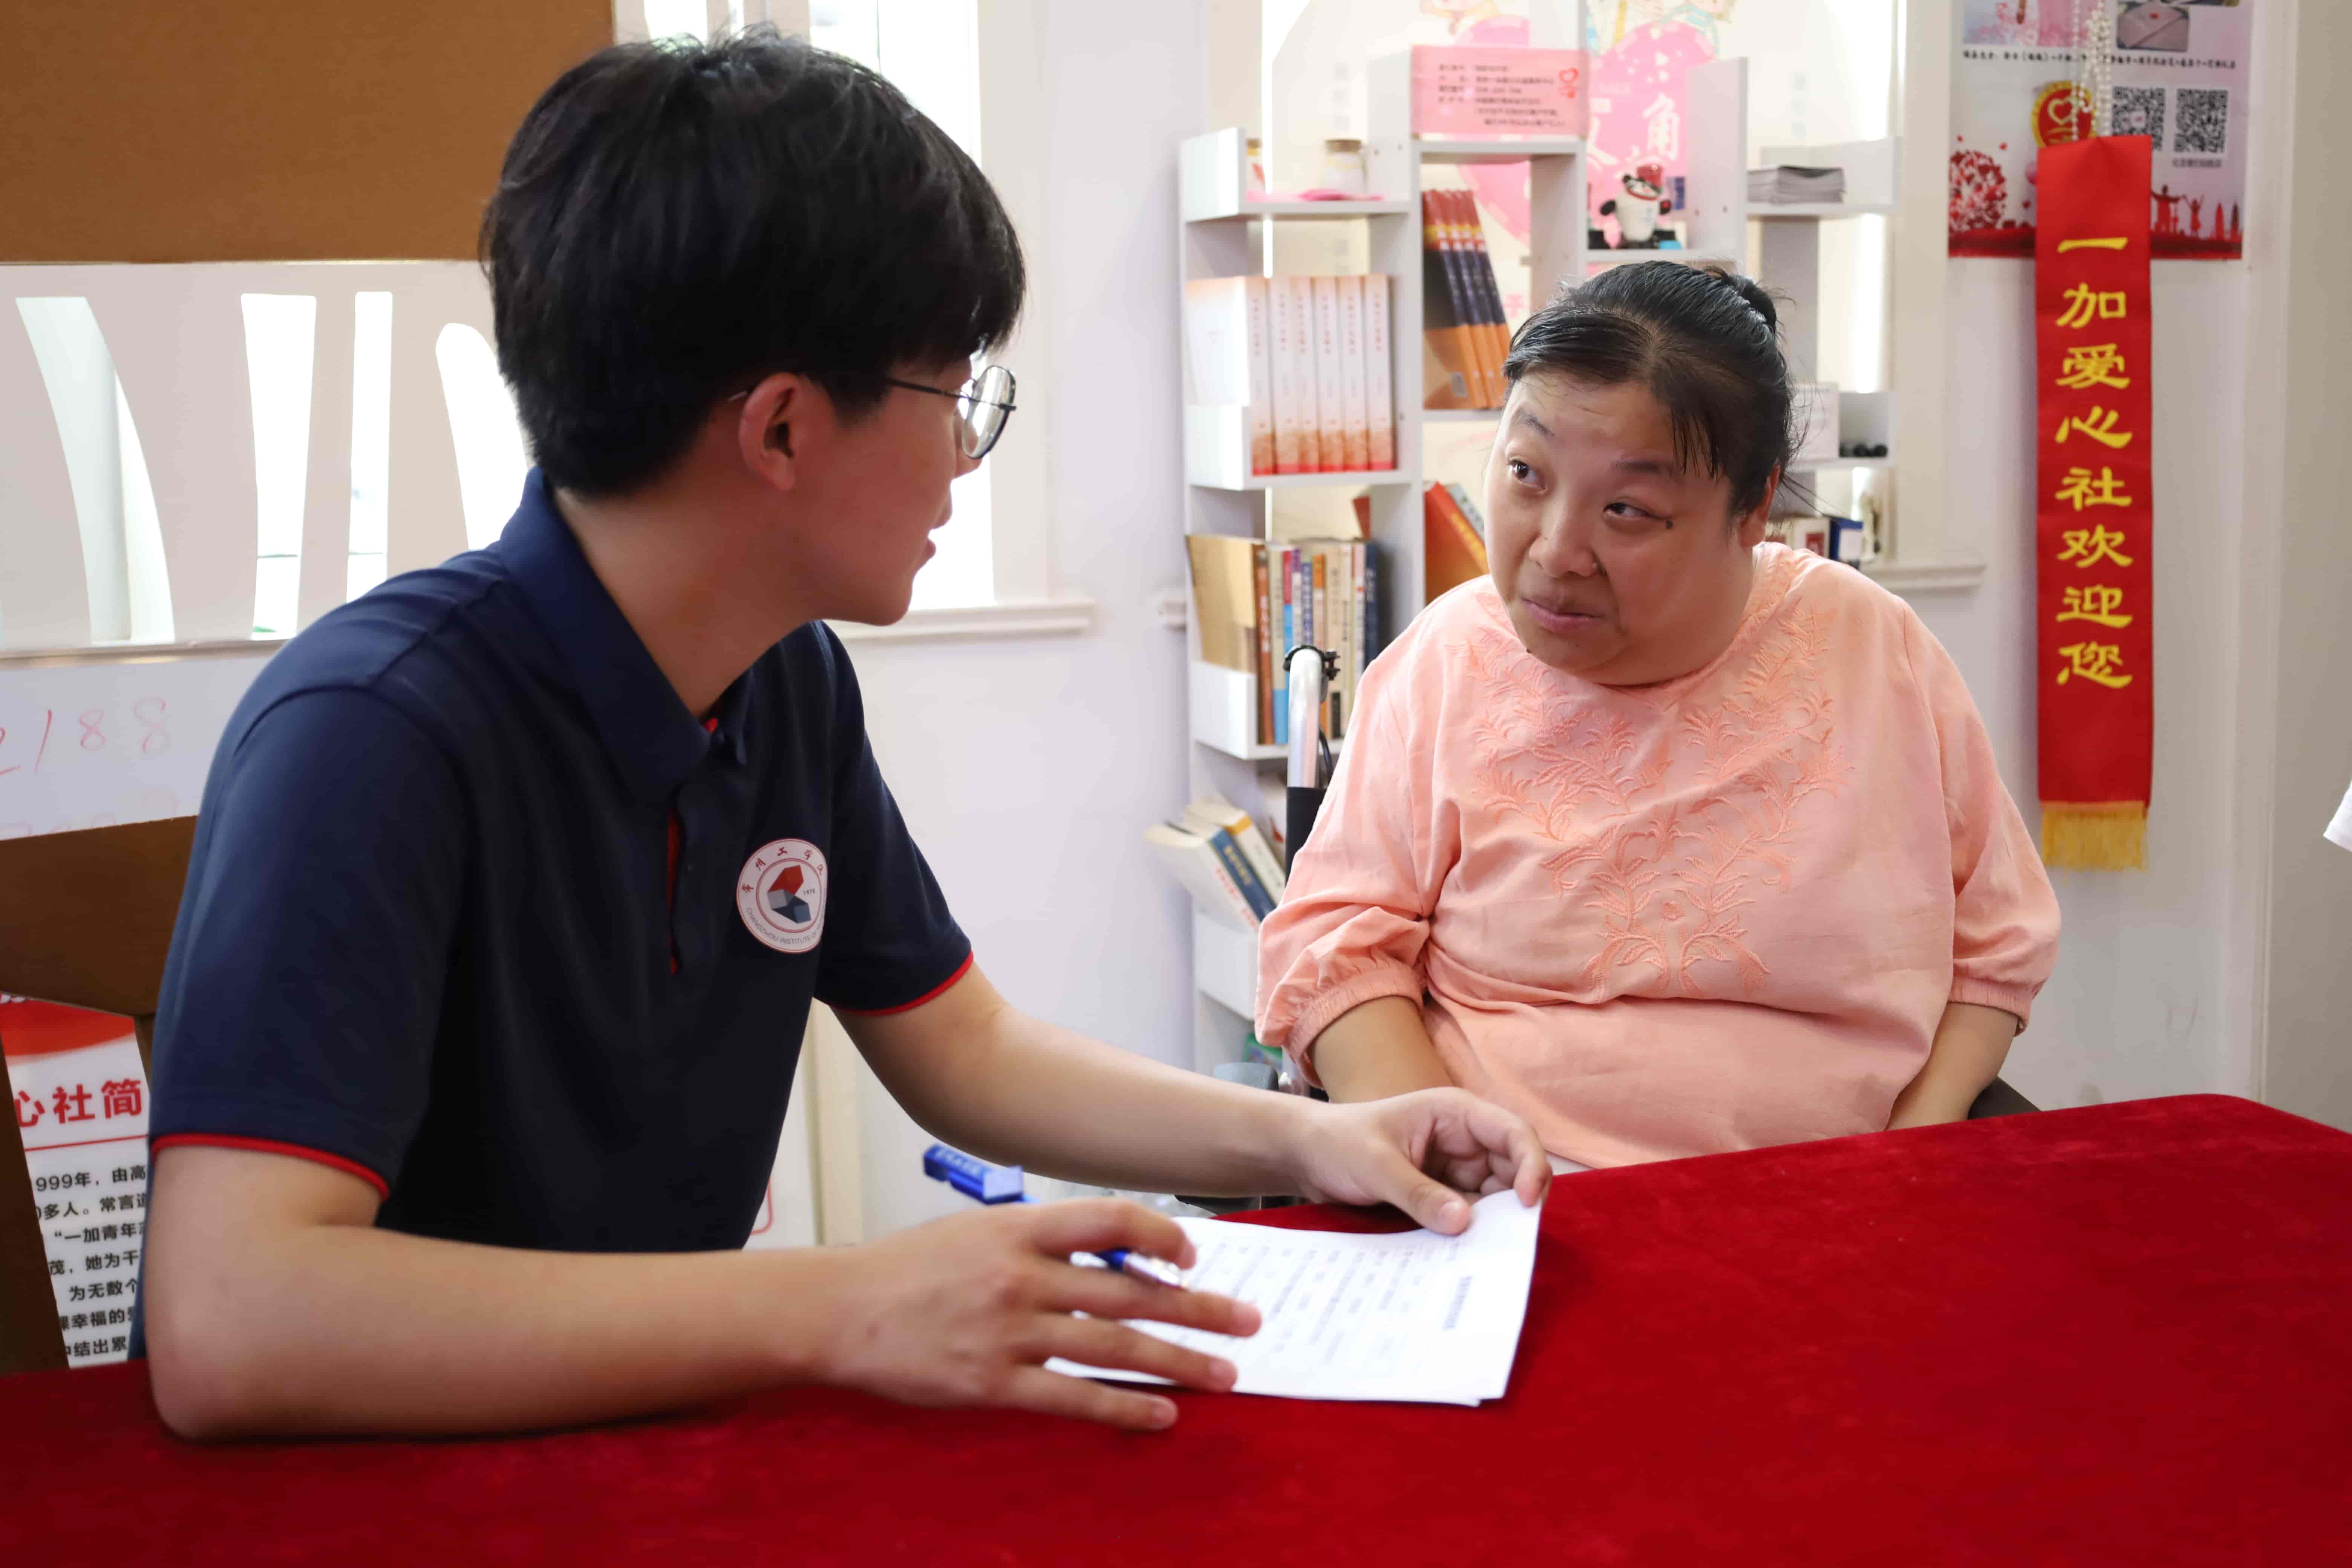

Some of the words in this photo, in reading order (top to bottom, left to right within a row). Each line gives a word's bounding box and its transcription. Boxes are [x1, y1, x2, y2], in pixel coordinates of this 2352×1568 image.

[2055, 236, 2133, 689] 一加爱心社欢迎您
[14, 1078, 142, 1128] 心社简
